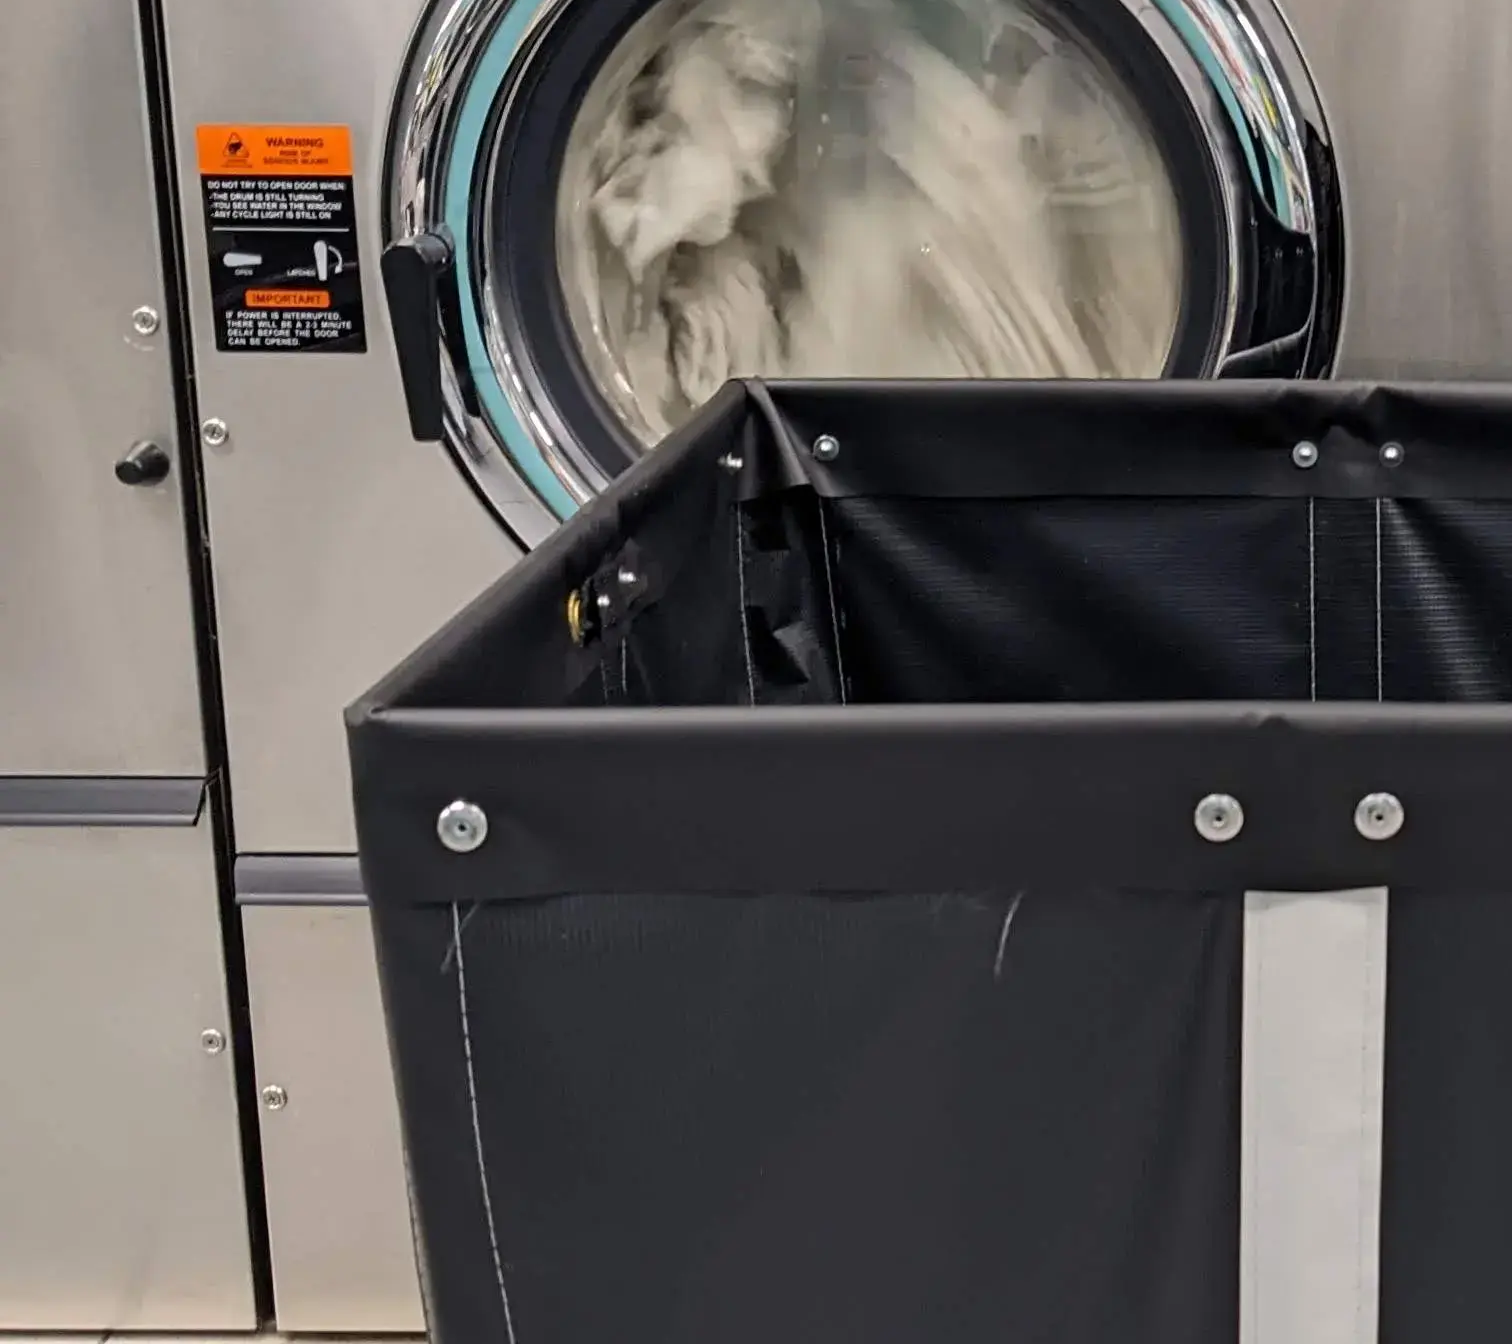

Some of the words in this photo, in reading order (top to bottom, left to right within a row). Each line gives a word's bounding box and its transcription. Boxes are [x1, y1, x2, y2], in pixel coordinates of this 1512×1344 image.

[266, 138, 324, 148] WARNING
[258, 182, 268, 190] TO
[270, 182, 292, 190] OPEN
[294, 182, 318, 190] DOOR
[252, 294, 321, 304] IMPORTANT
